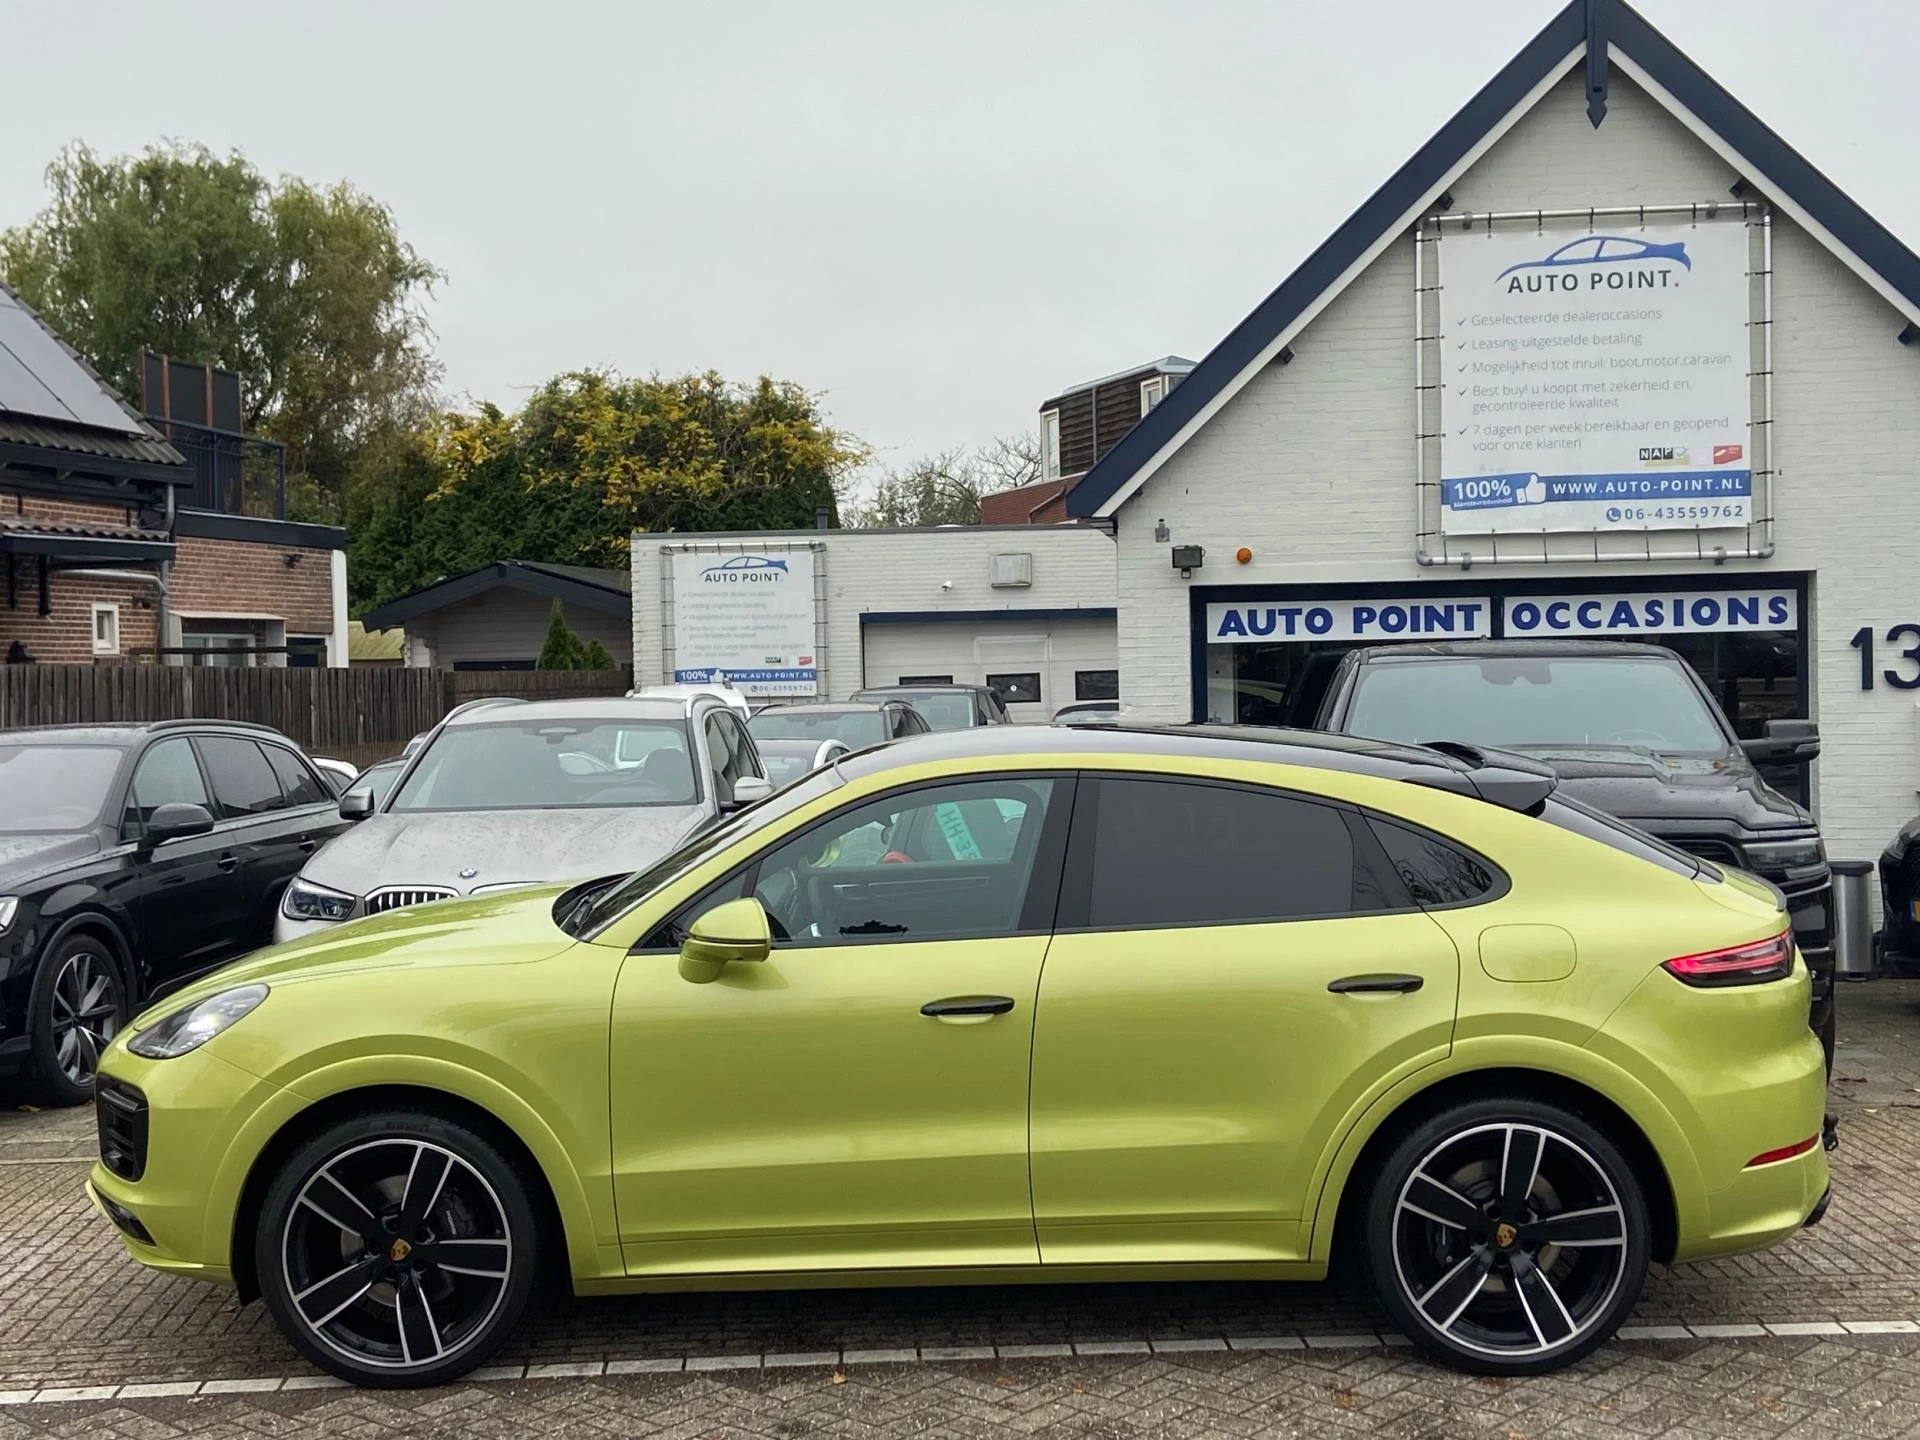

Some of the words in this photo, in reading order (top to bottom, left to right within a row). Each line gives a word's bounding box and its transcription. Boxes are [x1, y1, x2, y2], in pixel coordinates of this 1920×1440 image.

[1507, 273, 1578, 294] AUTO
[1590, 270, 1679, 290] POINT.
[1471, 312, 1559, 327] Geselecteerde
[1563, 310, 1663, 323] dealeroccasions
[1593, 332, 1642, 346] betaling
[1472, 360, 1548, 375] Mogelijkheid
[1552, 360, 1569, 371] tot
[1472, 385, 1499, 397] Best
[1502, 384, 1528, 399] buy!
[1531, 386, 1540, 395] u
[1543, 383, 1578, 397] koopt
[1582, 382, 1606, 393] met
[1609, 379, 1669, 393] zekerheid
[1472, 398, 1566, 415] gecontroleerde
[1569, 396, 1619, 409] kwaliteit
[1473, 425, 1480, 435] 7
[1483, 424, 1521, 438] dagen
[1525, 424, 1545, 437] per
[1549, 422, 1581, 433] week
[1584, 420, 1649, 432] bereikbaar
[1654, 420, 1670, 430] en
[1673, 417, 1729, 432] geopend
[1472, 442, 1500, 451] voor
[1503, 440, 1533, 451] onze
[1537, 438, 1582, 450] klanten
[1640, 448, 1673, 460] NAP
[1454, 479, 1512, 500] 100%
[1552, 477, 1744, 495] WWW.AUTO-POINT.NL
[1624, 505, 1743, 520] 06-43559762
[704, 573, 738, 583] AUTO
[1217, 607, 1333, 636] AUTO
[1353, 604, 1482, 634] POINT
[1511, 596, 1789, 630] OCCASIONS
[1850, 624, 1920, 690] 13
[681, 670, 708, 681] 100%
